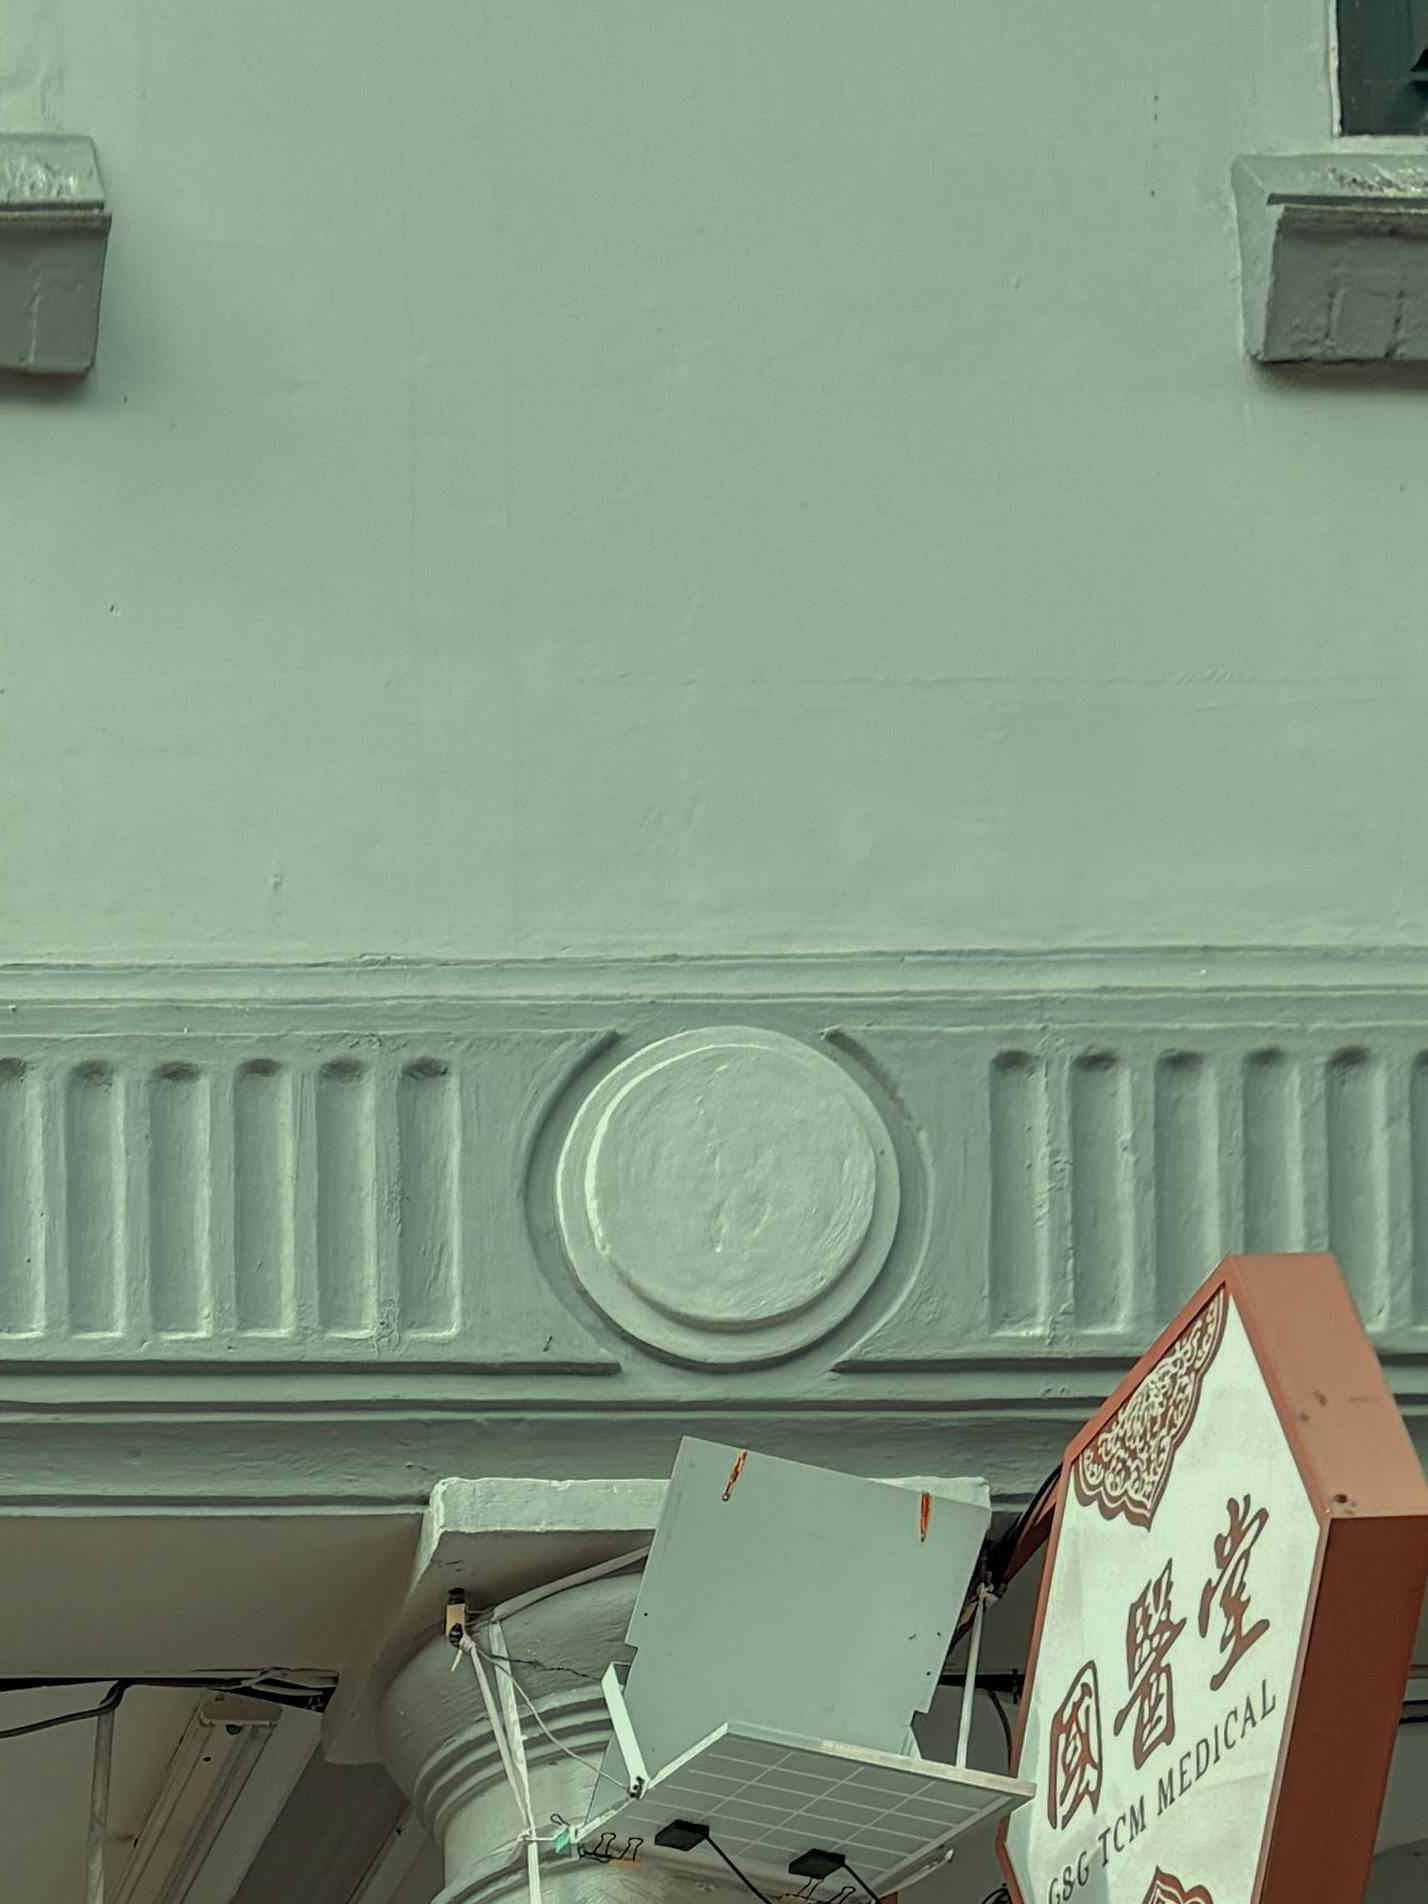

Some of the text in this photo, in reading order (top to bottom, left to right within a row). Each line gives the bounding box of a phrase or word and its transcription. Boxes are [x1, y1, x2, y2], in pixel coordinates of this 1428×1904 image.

[1048, 1493, 1270, 1830] 國醫堂
[1097, 1803, 1147, 1870] TCM
[1156, 1678, 1277, 1818] MEDICAL
